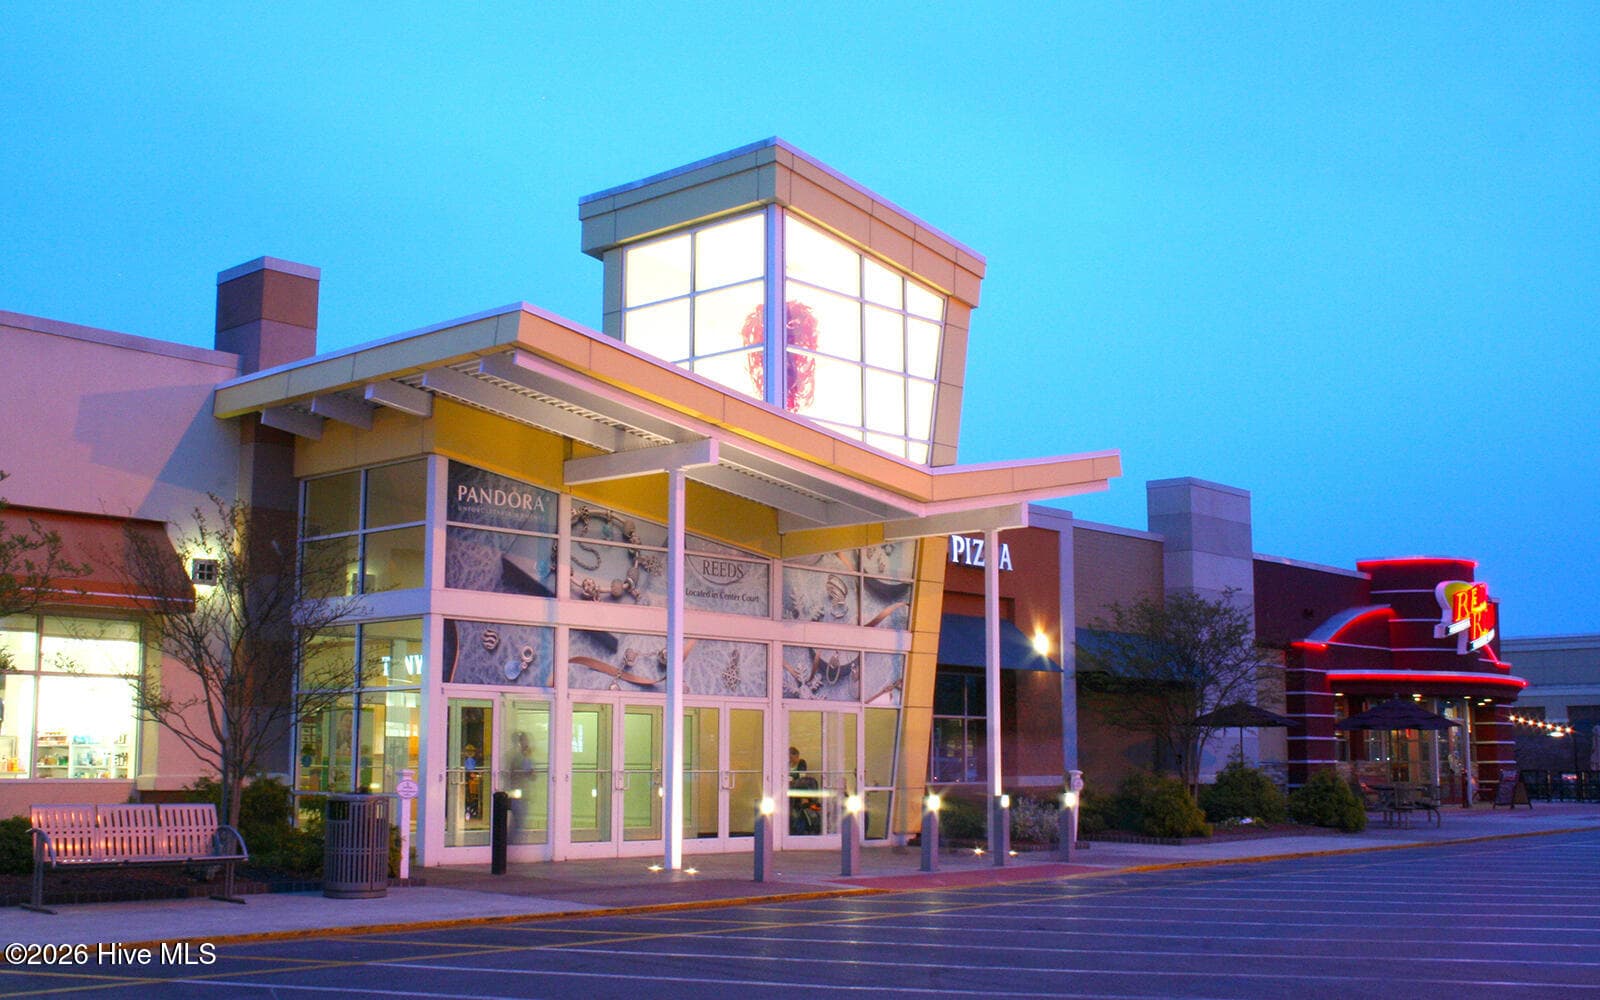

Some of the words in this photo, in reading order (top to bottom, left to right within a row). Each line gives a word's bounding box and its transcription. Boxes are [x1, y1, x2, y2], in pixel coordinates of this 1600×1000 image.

[457, 485, 545, 511] PANDORA
[951, 534, 1014, 571] PIZA
[703, 560, 745, 580] REEDS
[685, 587, 711, 599] Located
[719, 592, 741, 602] Center
[741, 593, 760, 603] Court
